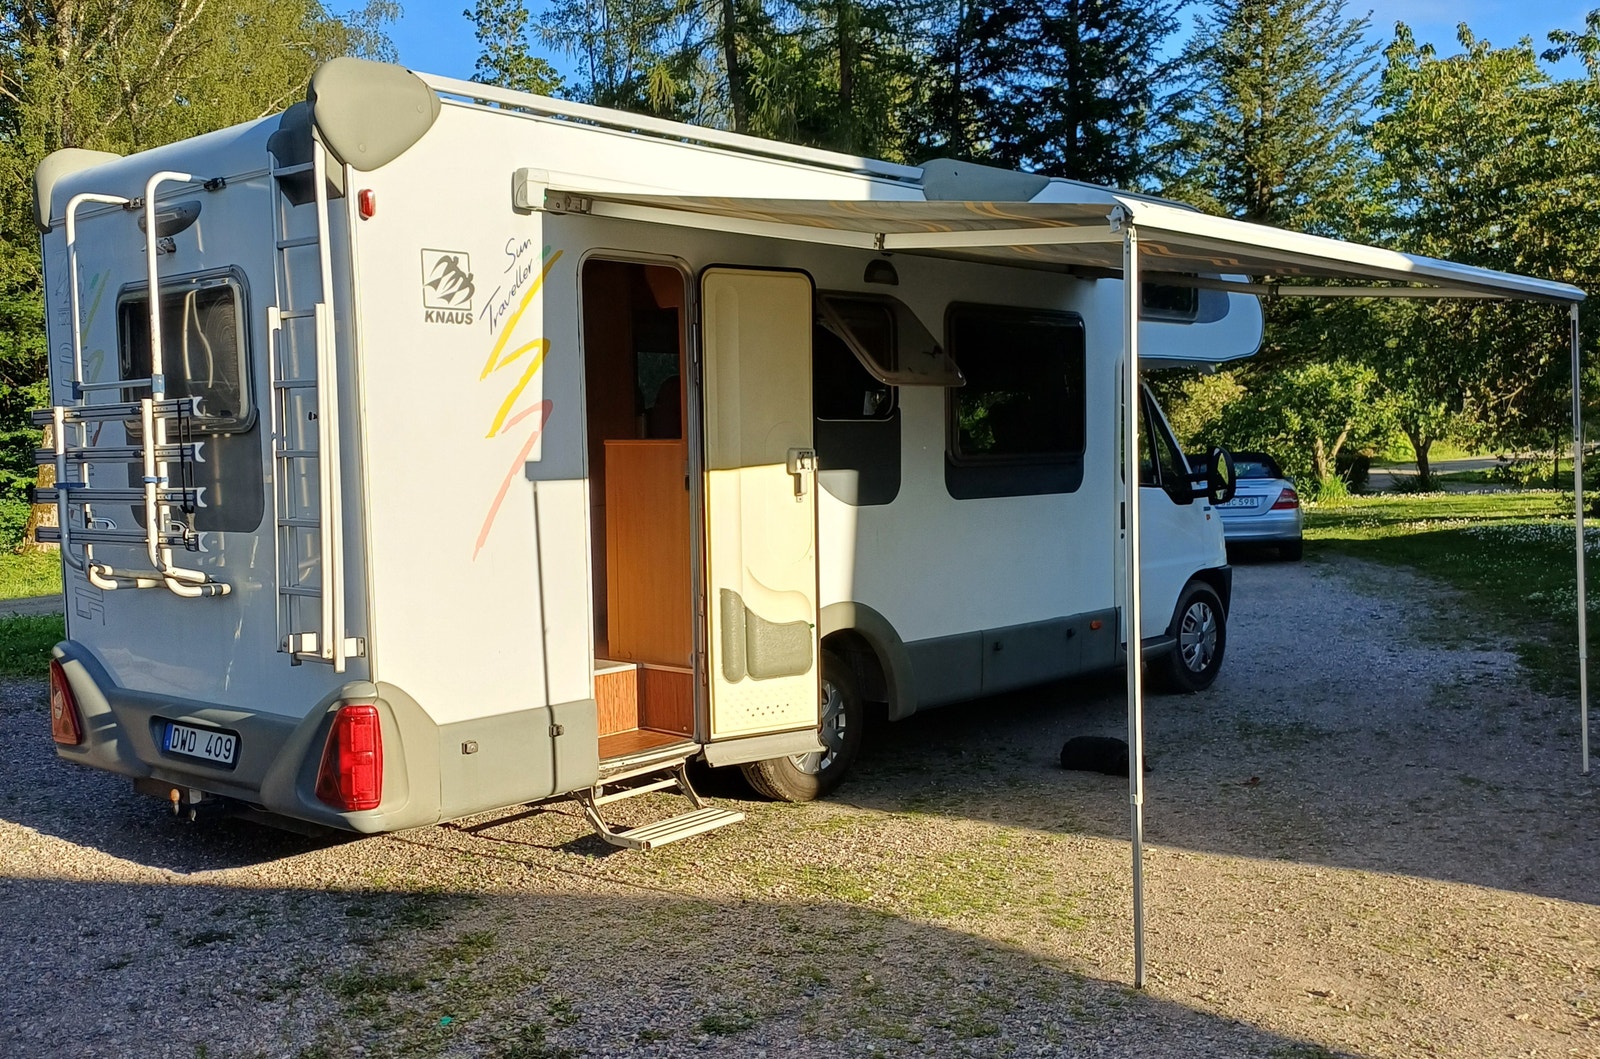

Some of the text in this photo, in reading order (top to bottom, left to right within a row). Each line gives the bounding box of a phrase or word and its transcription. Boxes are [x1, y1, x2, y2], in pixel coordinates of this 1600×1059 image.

[504, 237, 532, 274] Sun
[479, 258, 533, 335] Traveller
[424, 310, 474, 325] KNAUS
[1238, 498, 1255, 506] 598
[171, 727, 233, 760] DWD 409
